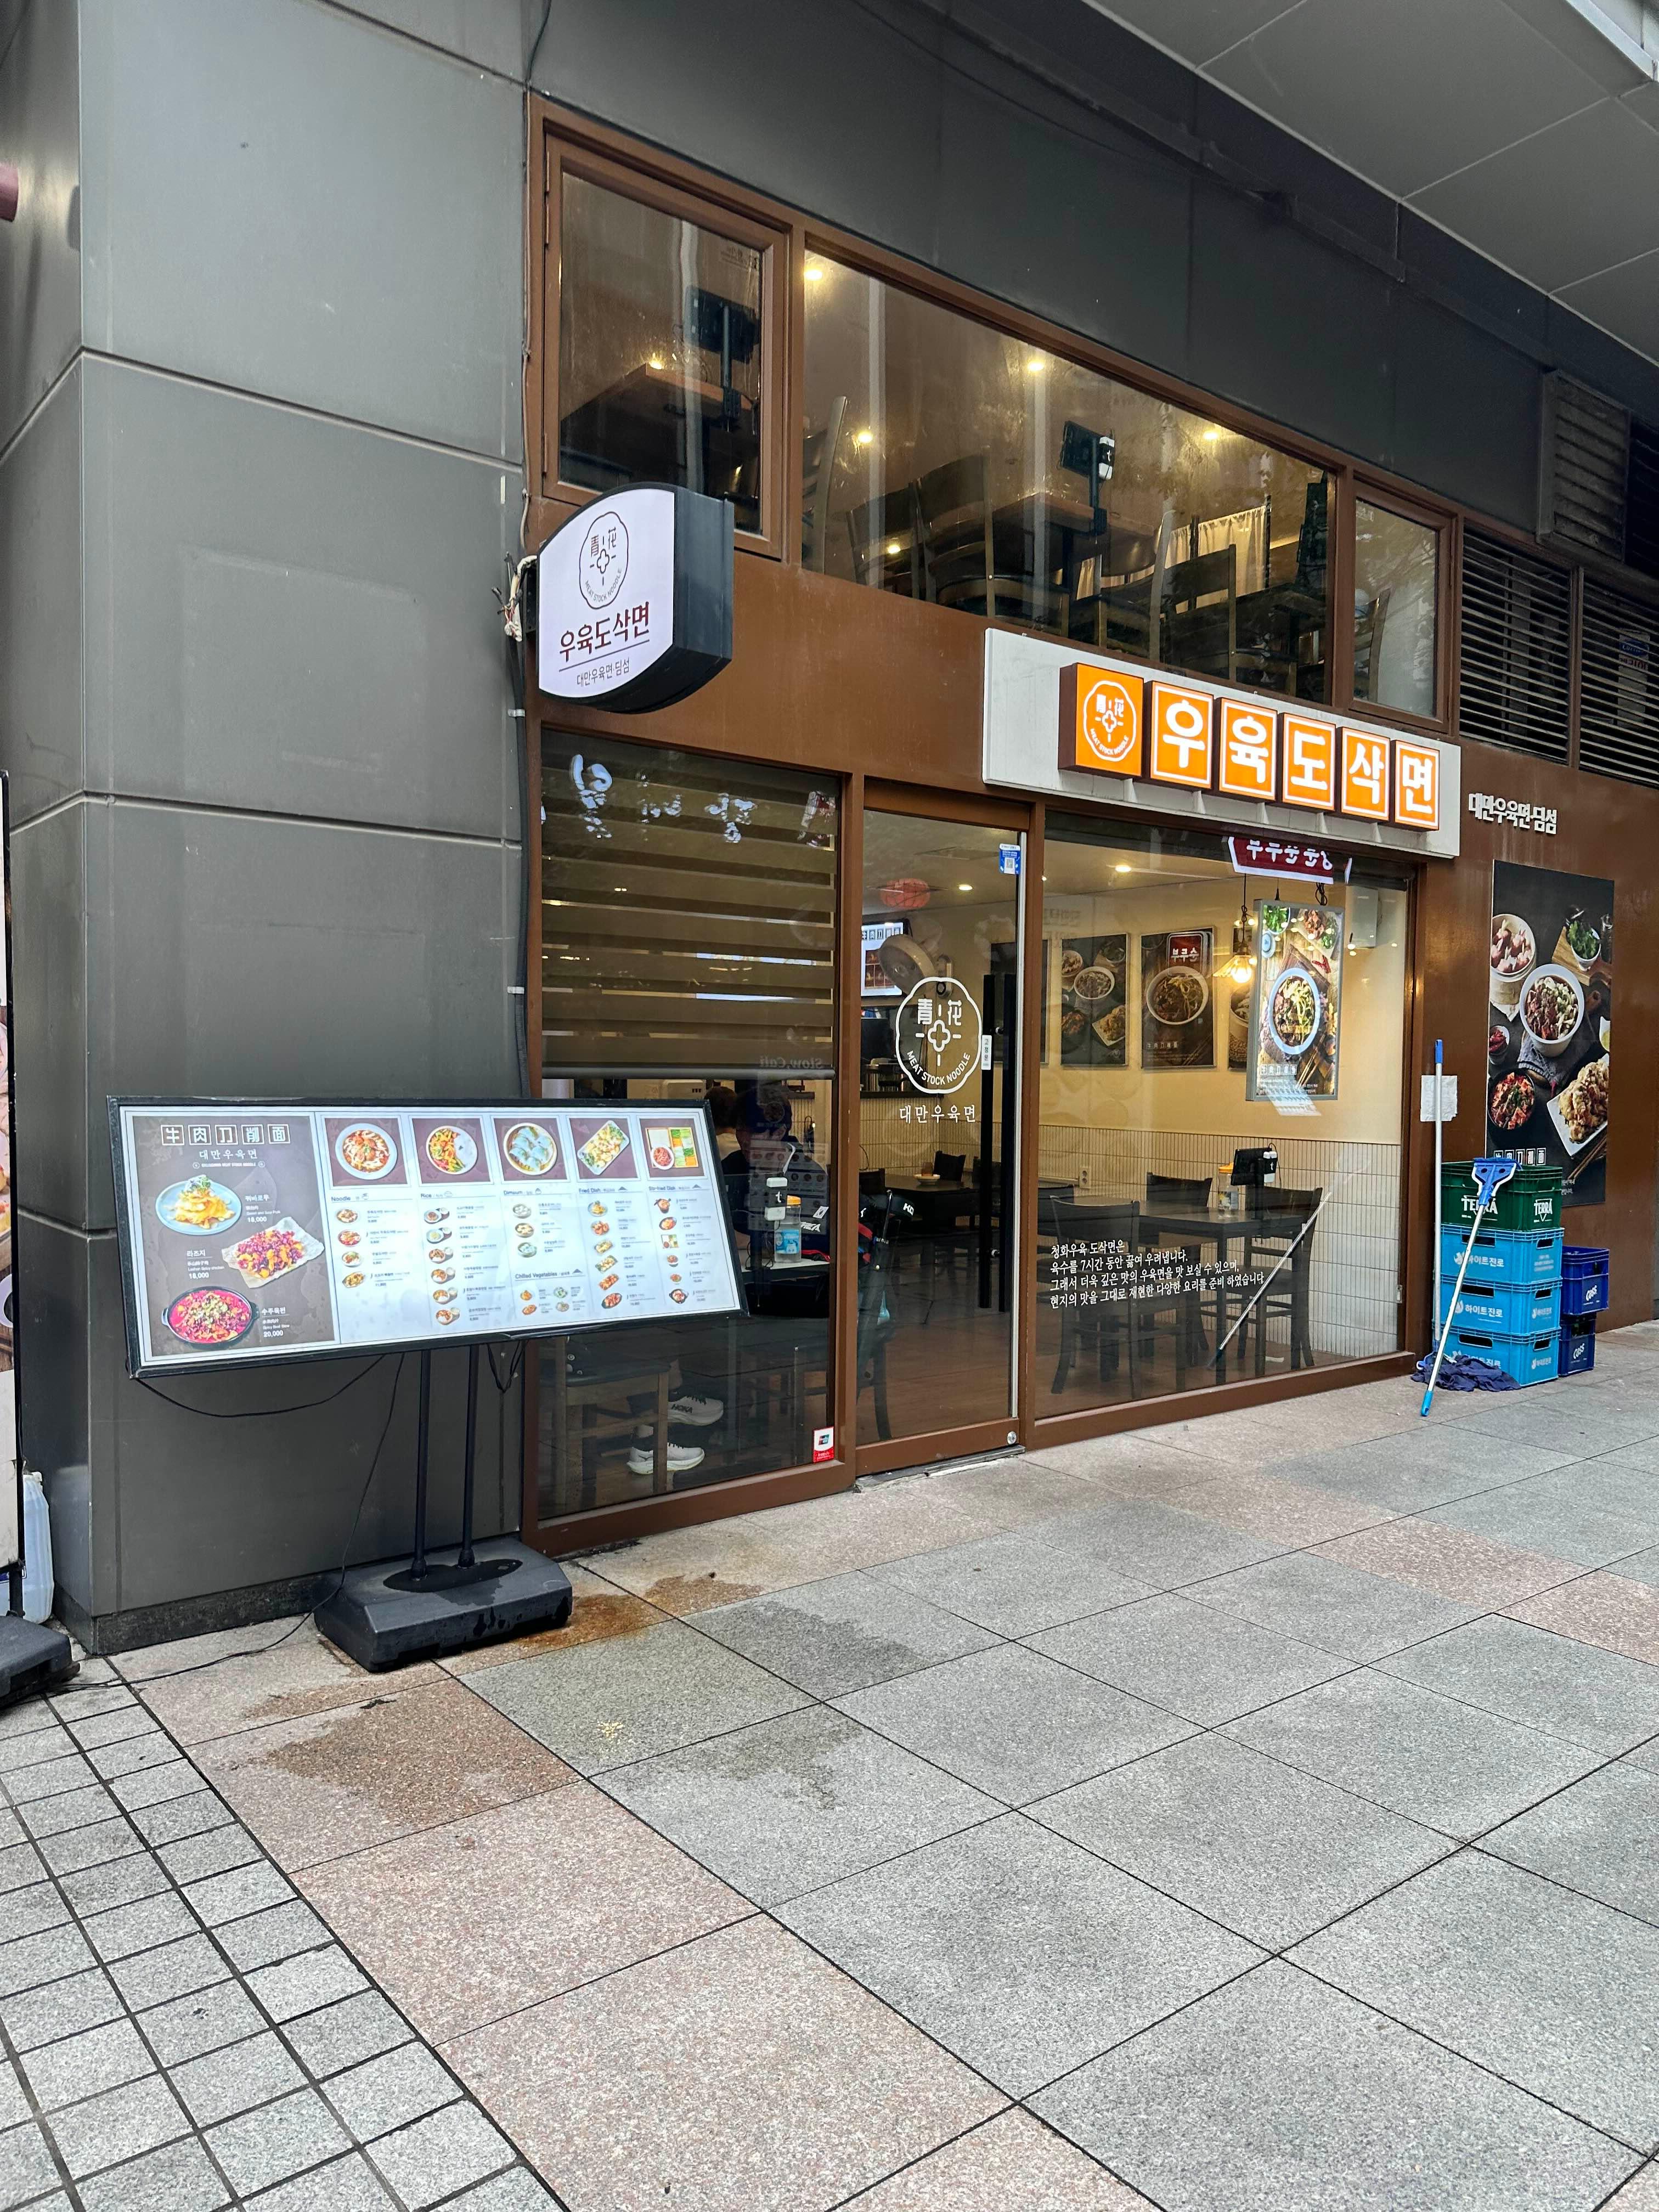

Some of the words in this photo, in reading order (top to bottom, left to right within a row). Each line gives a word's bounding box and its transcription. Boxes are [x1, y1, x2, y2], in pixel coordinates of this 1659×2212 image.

[585, 580, 594, 598] MEAT
[593, 594, 607, 603] STOCK
[560, 601, 650, 663] 우육도삭면
[1163, 699, 1433, 814] 우육도삭면
[907, 1050, 923, 1076] MEAT
[921, 1071, 946, 1086] STOCK
[946, 1052, 971, 1084] NOODLE
[900, 1104, 976, 1124] 대만우육면
[199, 1149, 258, 1160] 대만우육면
[1533, 1201, 1553, 1216] TERRA
[1051, 1242, 1087, 1259] 청화우육
[1089, 1239, 1125, 1255] 도삭면은
[1049, 1260, 1079, 1276] 육수를
[1081, 1257, 1104, 1272] 7시간
[1105, 1255, 1124, 1271] 동안
[1125, 1253, 1143, 1268] 끓여
[1144, 1249, 1188, 1266] 우려냅니다.
[1049, 1276, 1077, 1291] 그래서
[1081, 1274, 1098, 1289] 더욱
[1101, 1272, 1119, 1287] 깊은
[1121, 1269, 1138, 1285] 맛의
[1139, 1266, 1173, 1283] 우육면을
[1175, 1265, 1184, 1279] 맛
[1186, 1263, 1201, 1277] 보실
[1204, 1263, 1212, 1275] 수
[1215, 1260, 1239, 1274] 있으며,
[1049, 1292, 1077, 1309] 현지의
[1080, 1290, 1098, 1306] 맛을
[1100, 1288, 1127, 1302] 그대로
[1129, 1284, 1155, 1299] 재현한
[1156, 1280, 1181, 1296] 다양한
[1183, 1277, 1207, 1292] 요리를
[1209, 1276, 1224, 1290] 준비
[1465, 1304, 1503, 1317] 하이트진로
